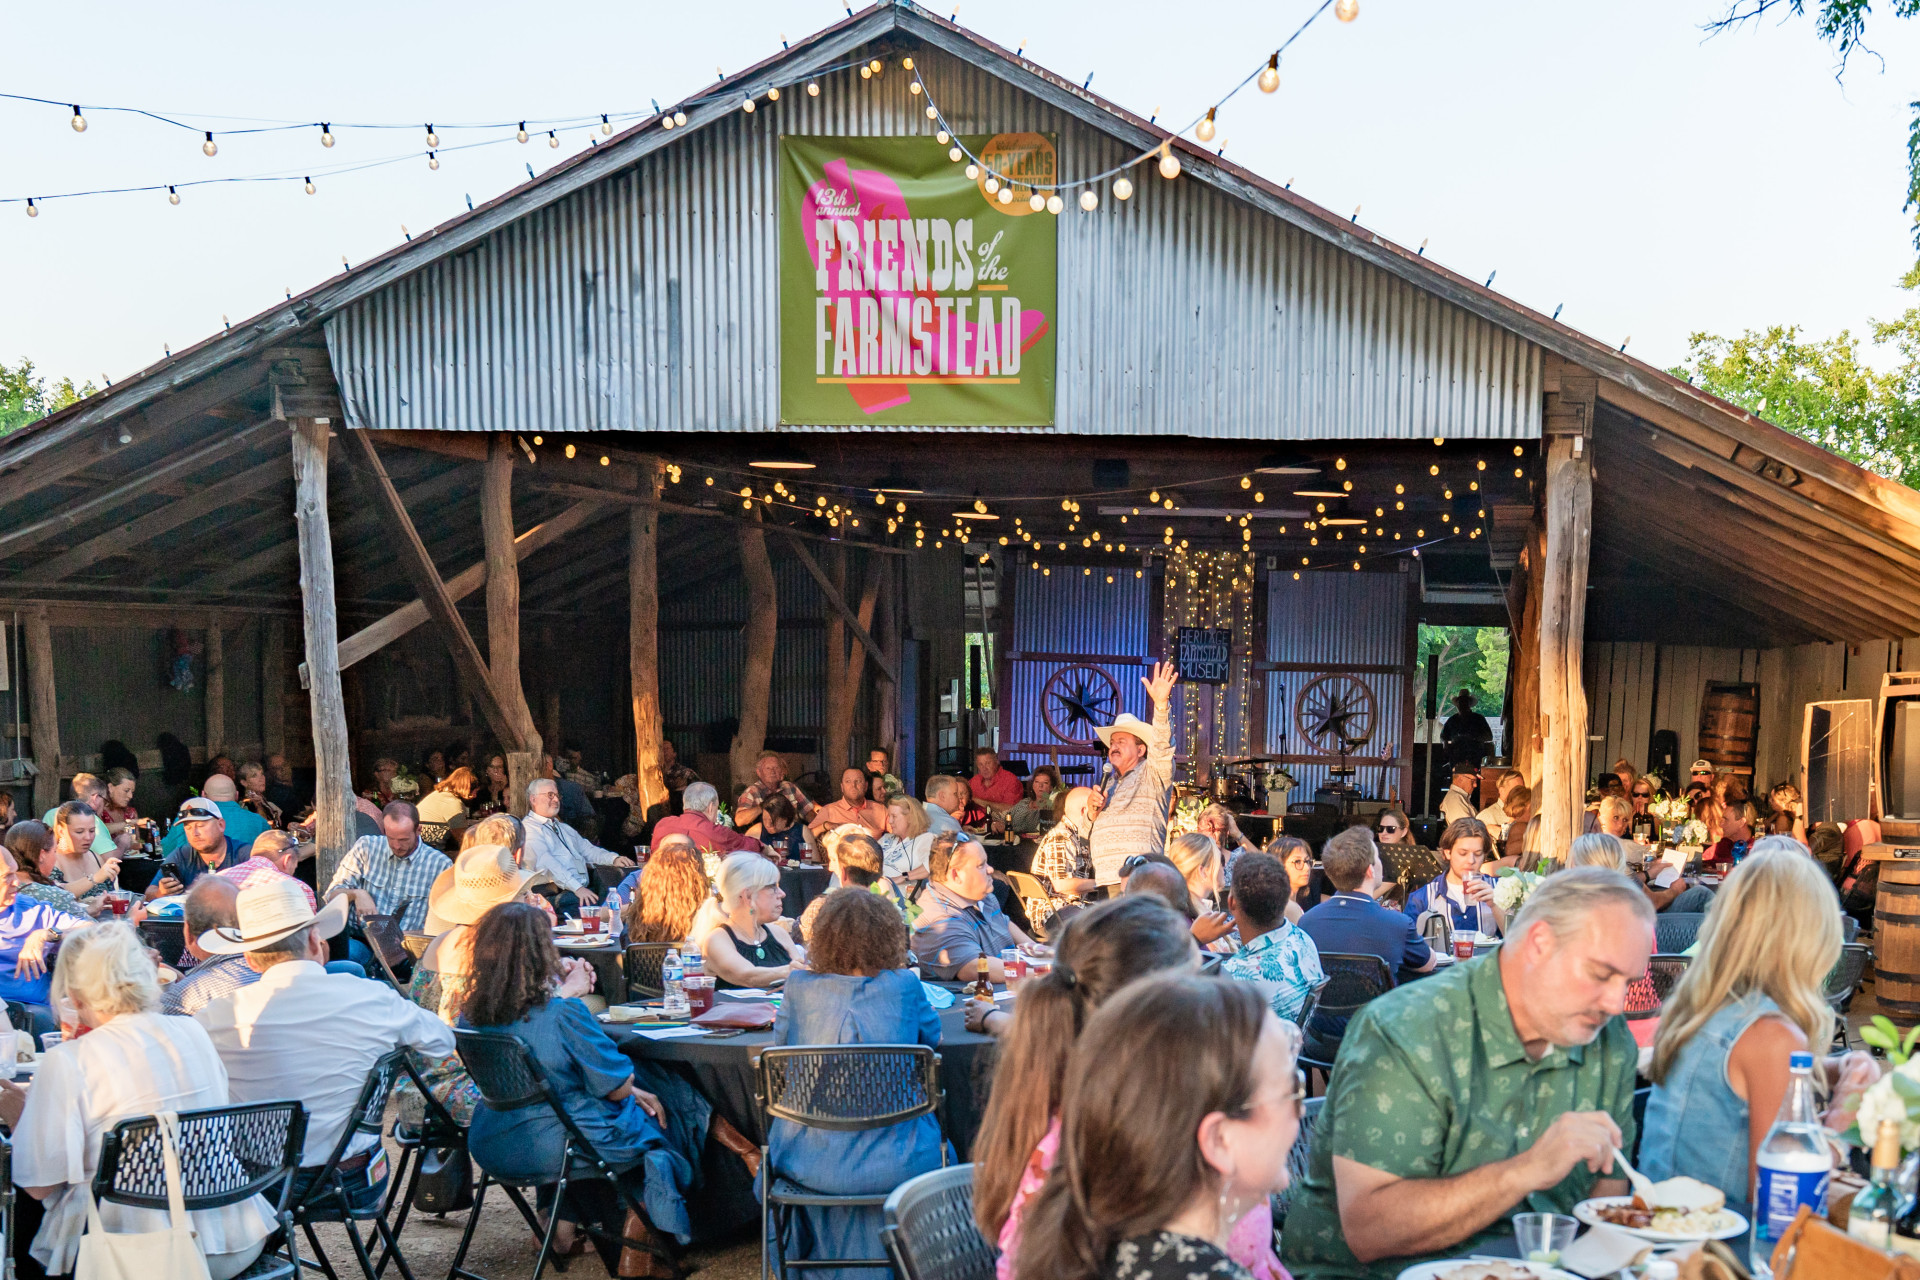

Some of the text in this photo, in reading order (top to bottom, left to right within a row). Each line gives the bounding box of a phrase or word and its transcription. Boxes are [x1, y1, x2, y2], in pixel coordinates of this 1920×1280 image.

[985, 152, 1054, 175] 50-YEARS
[815, 188, 848, 205] 13th
[815, 202, 861, 216] annual
[816, 218, 974, 291] FRIENDS
[977, 230, 1004, 262] of
[977, 254, 1009, 281] the
[816, 297, 1021, 375] FARMSTEAD
[1180, 629, 1229, 645] HERITAGE
[1180, 645, 1228, 662] FARMSTEAD
[1180, 662, 1229, 680] MUSEUM
